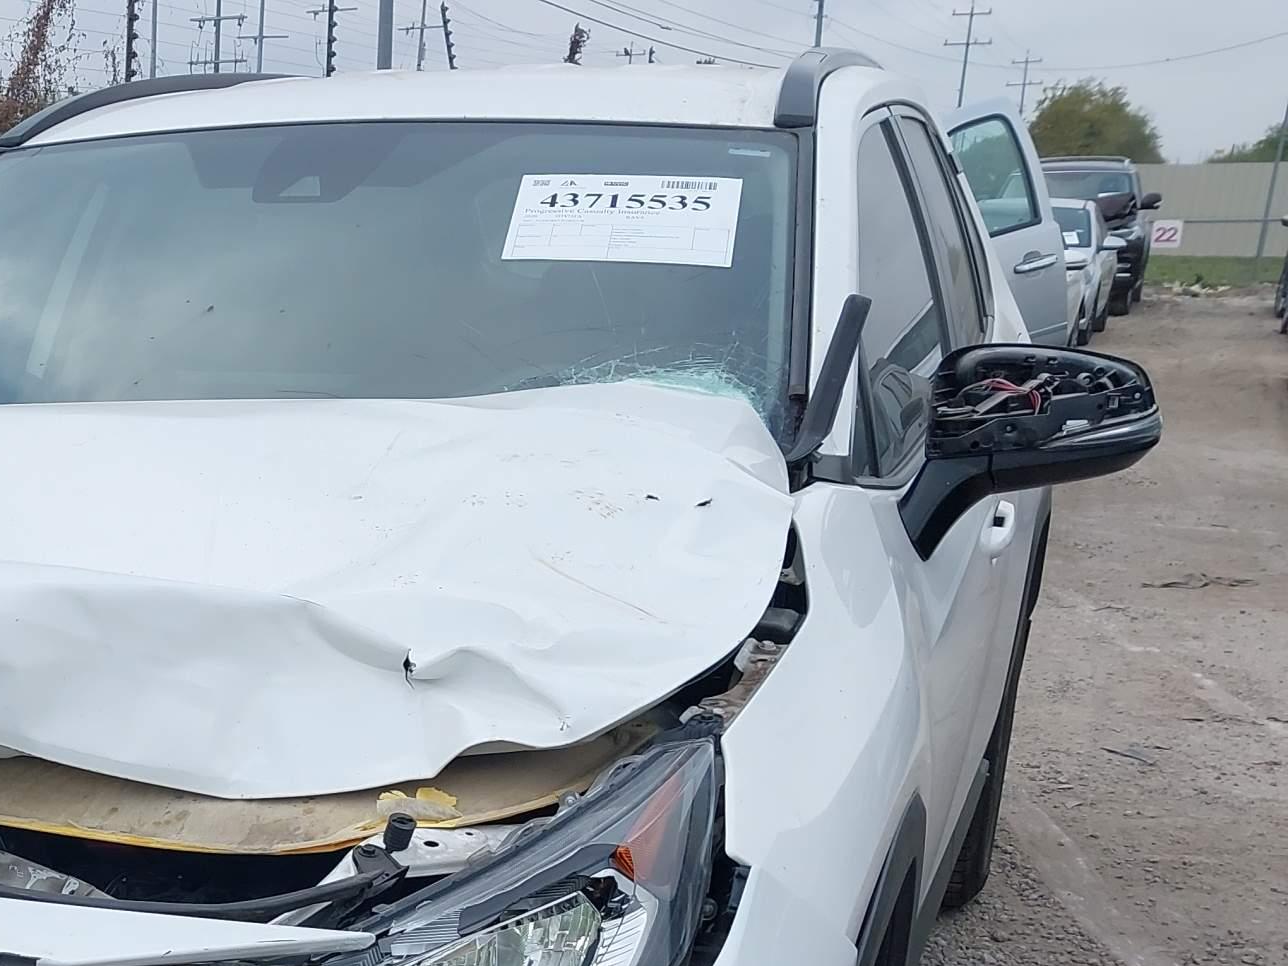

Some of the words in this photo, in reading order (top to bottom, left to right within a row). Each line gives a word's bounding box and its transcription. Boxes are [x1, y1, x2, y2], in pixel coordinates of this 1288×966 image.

[539, 193, 711, 211] 43715535
[524, 207, 574, 215] Progressive
[577, 207, 615, 215] Casualty
[618, 208, 661, 216] Insurance
[1154, 226, 1178, 243] 22
